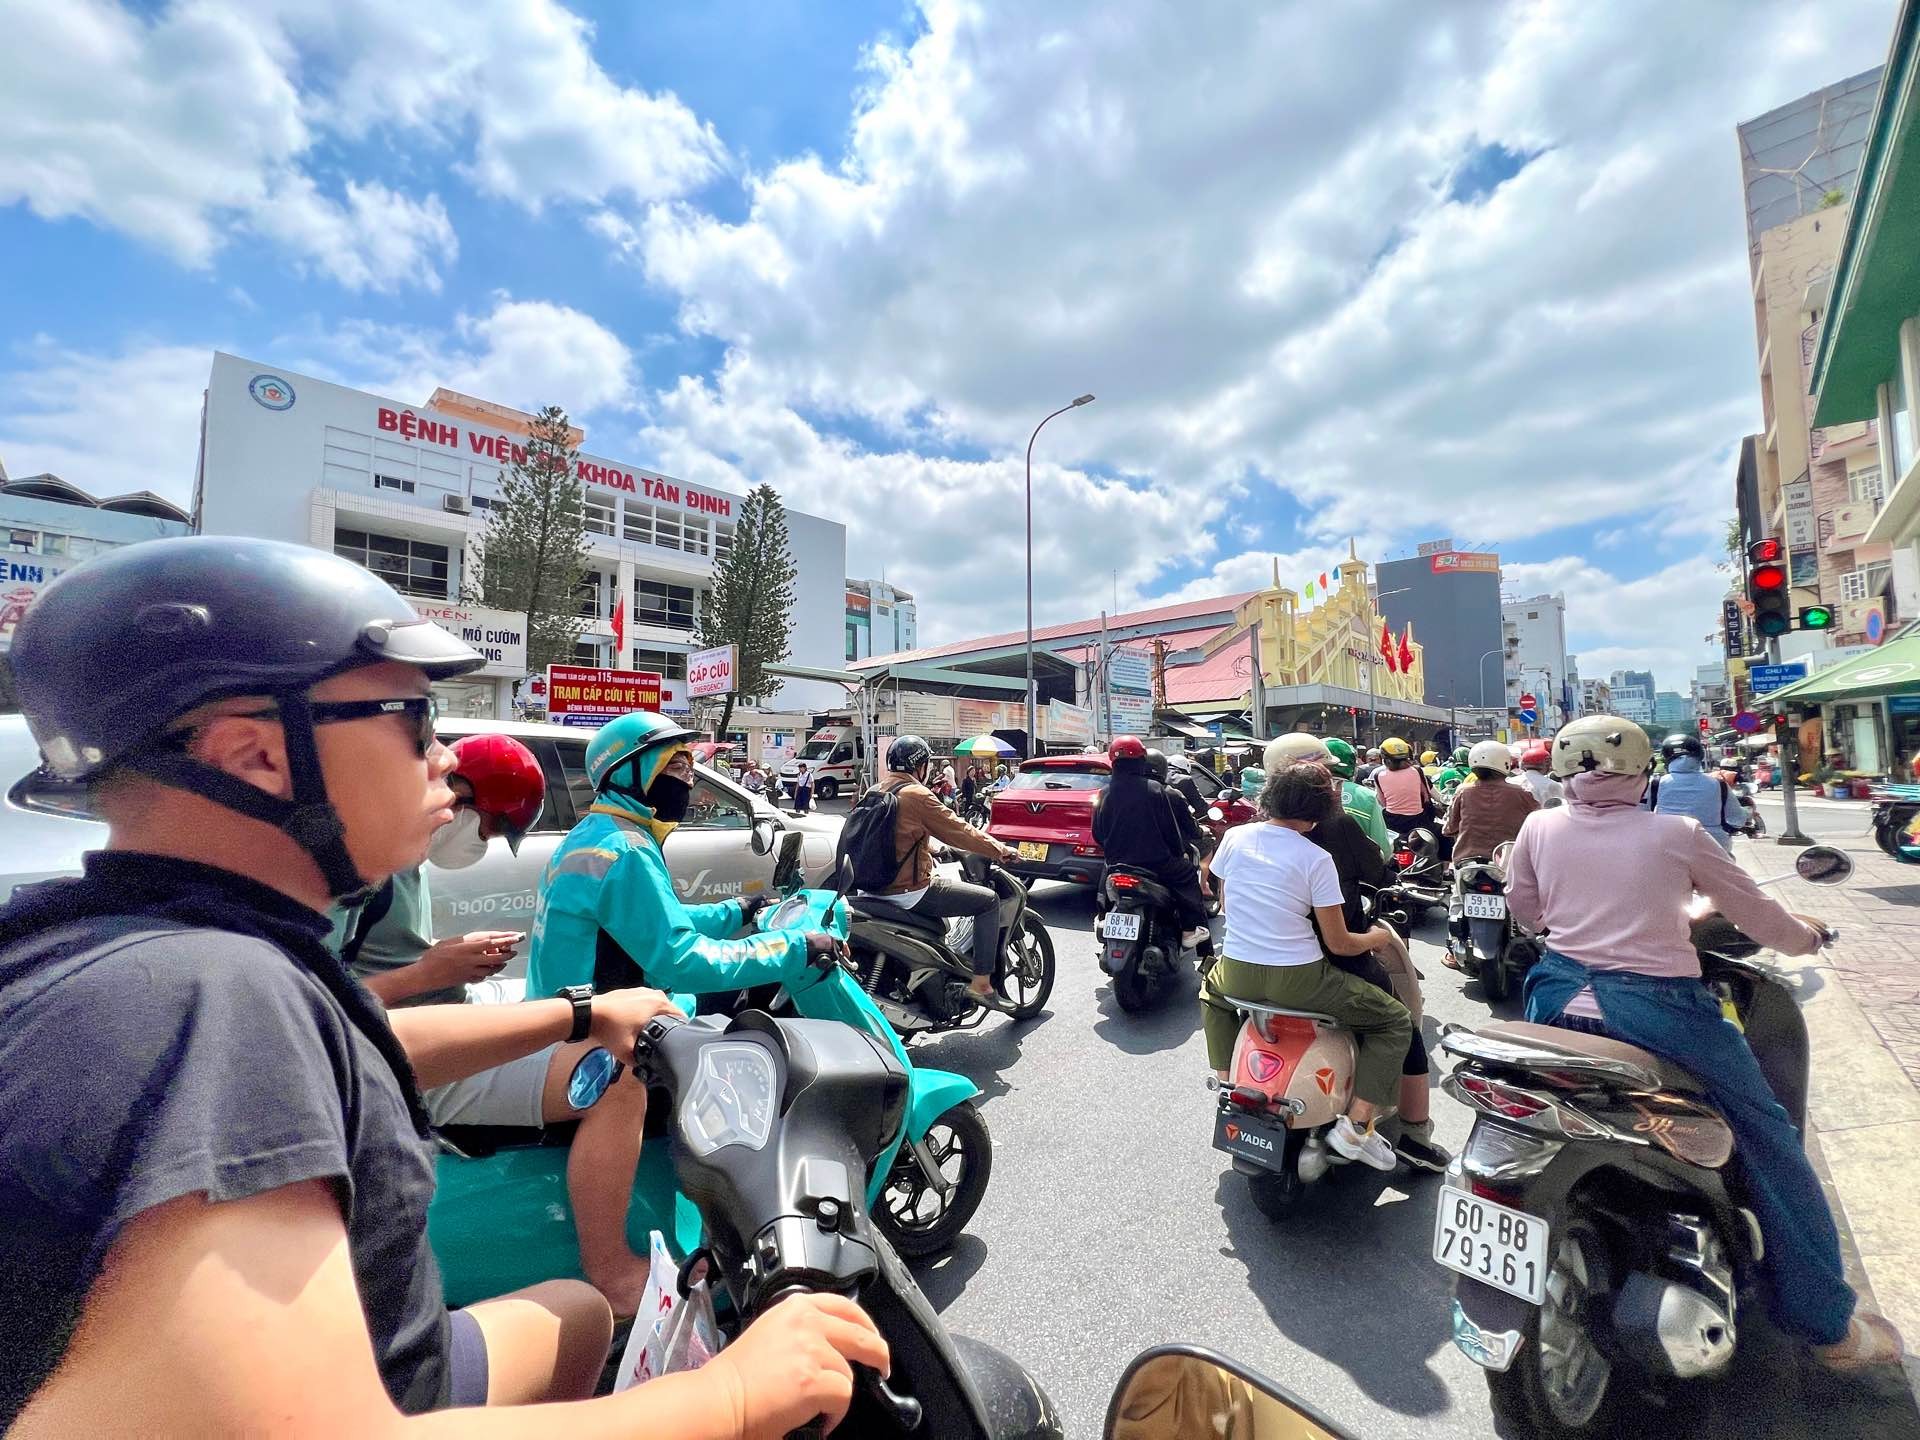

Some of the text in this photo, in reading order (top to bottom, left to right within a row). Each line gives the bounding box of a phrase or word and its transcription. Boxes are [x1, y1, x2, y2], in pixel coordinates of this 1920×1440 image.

[378, 408, 458, 449] BỆNH
[469, 432, 528, 465] VIỆN
[577, 461, 636, 493] KHOA
[641, 478, 680, 504] TÂN
[686, 490, 730, 516] ĐỊNH
[486, 629, 521, 645] CƯỜM
[1726, 604, 1740, 656] HUSTLE
[597, 671, 612, 683] 115
[689, 660, 729, 683] CẤP CỨU
[553, 683, 658, 706] TRẠM CẤP CỨU VỆ TINH
[702, 881, 742, 896] XANH
[450, 898, 497, 917] 1900
[1471, 895, 1498, 907] 59-V1
[1110, 914, 1134, 927] 68-NA
[1240, 1130, 1274, 1152] YADEA
[1455, 1198, 1529, 1252] 60-B8
[1441, 1227, 1536, 1296] 793.61
